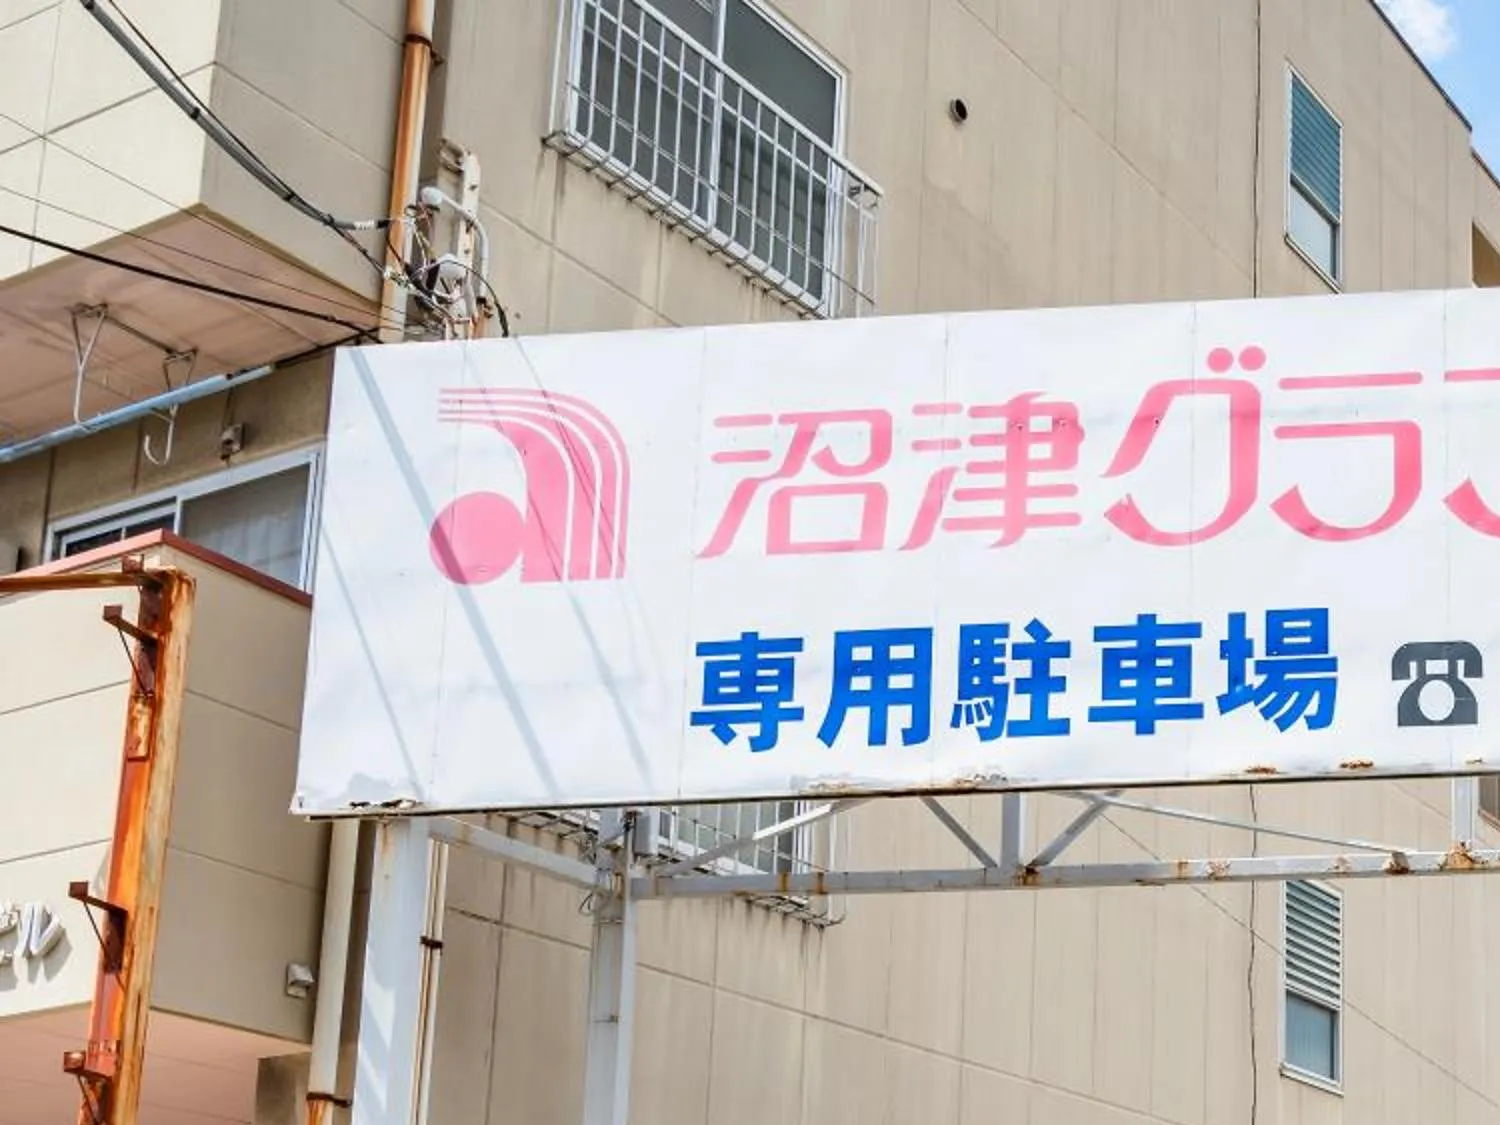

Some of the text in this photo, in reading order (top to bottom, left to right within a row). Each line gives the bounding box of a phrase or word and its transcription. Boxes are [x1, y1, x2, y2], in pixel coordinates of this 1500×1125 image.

[689, 606, 1339, 754] 専用駐車場
